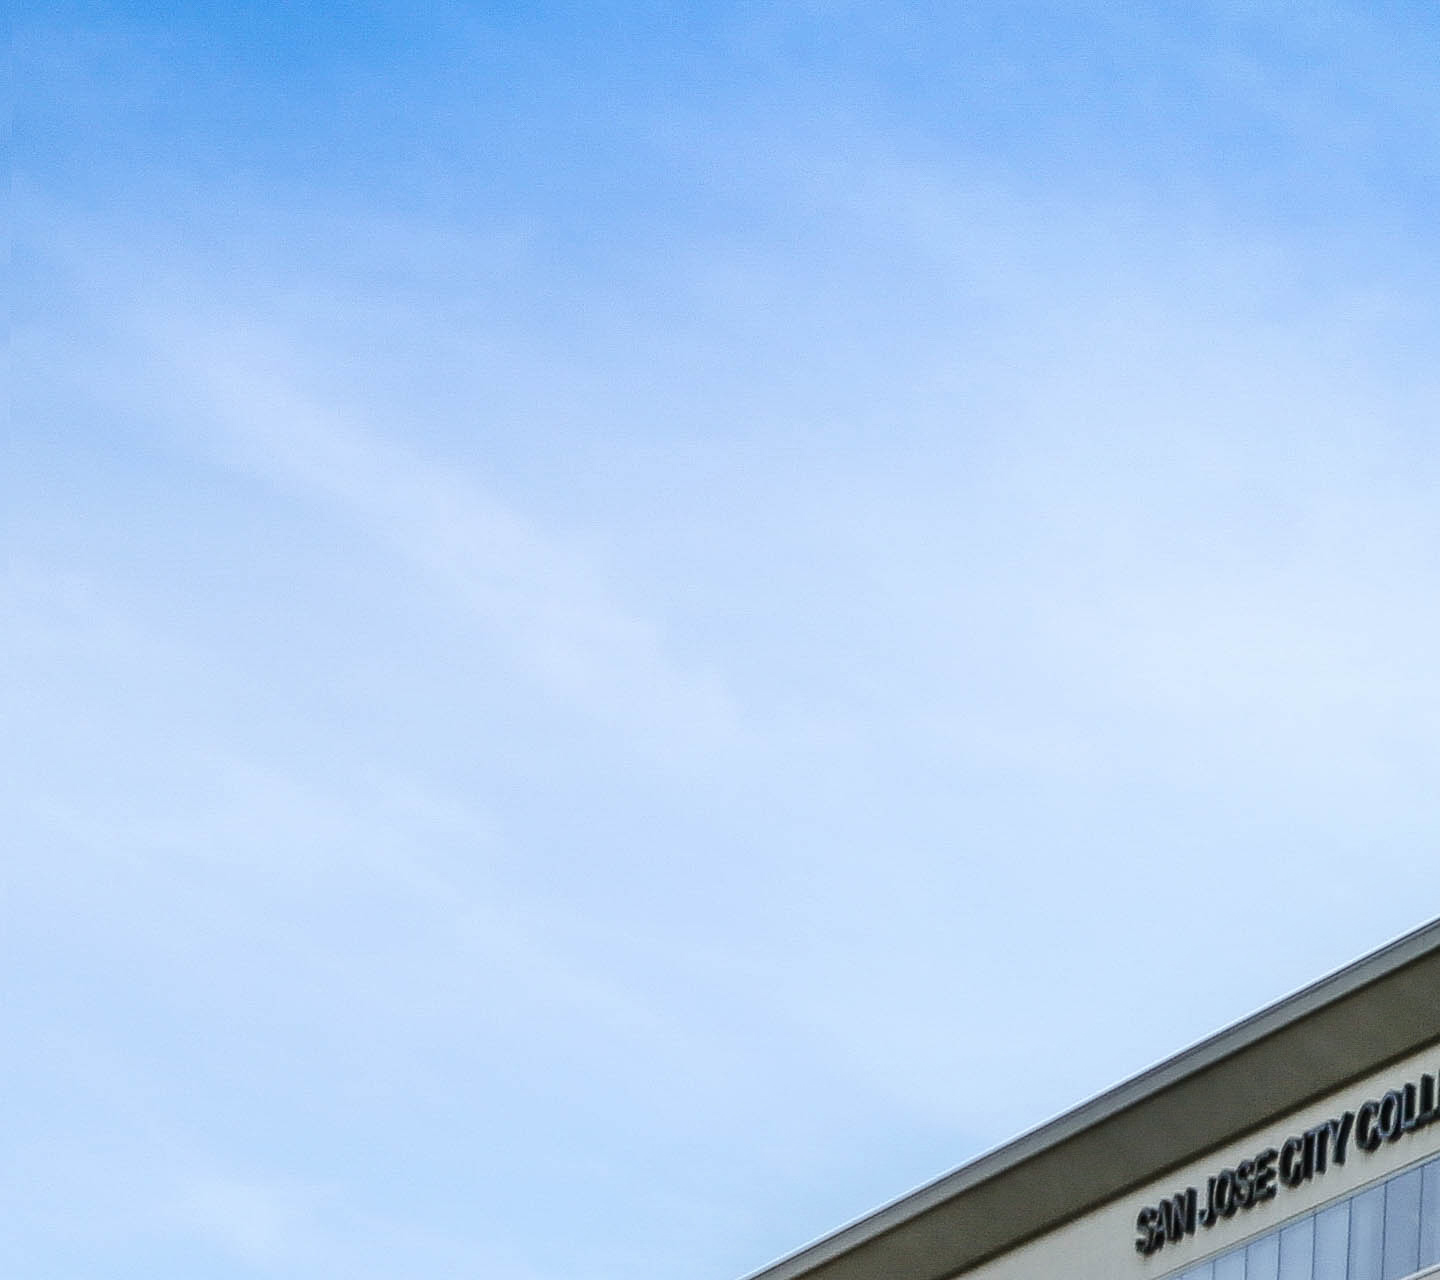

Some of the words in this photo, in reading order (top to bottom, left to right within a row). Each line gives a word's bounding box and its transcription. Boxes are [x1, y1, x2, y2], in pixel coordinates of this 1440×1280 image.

[1135, 1187, 1196, 1255] SAN
[1198, 1148, 1277, 1227] JOSE
[1279, 1111, 1353, 1188] CITY
